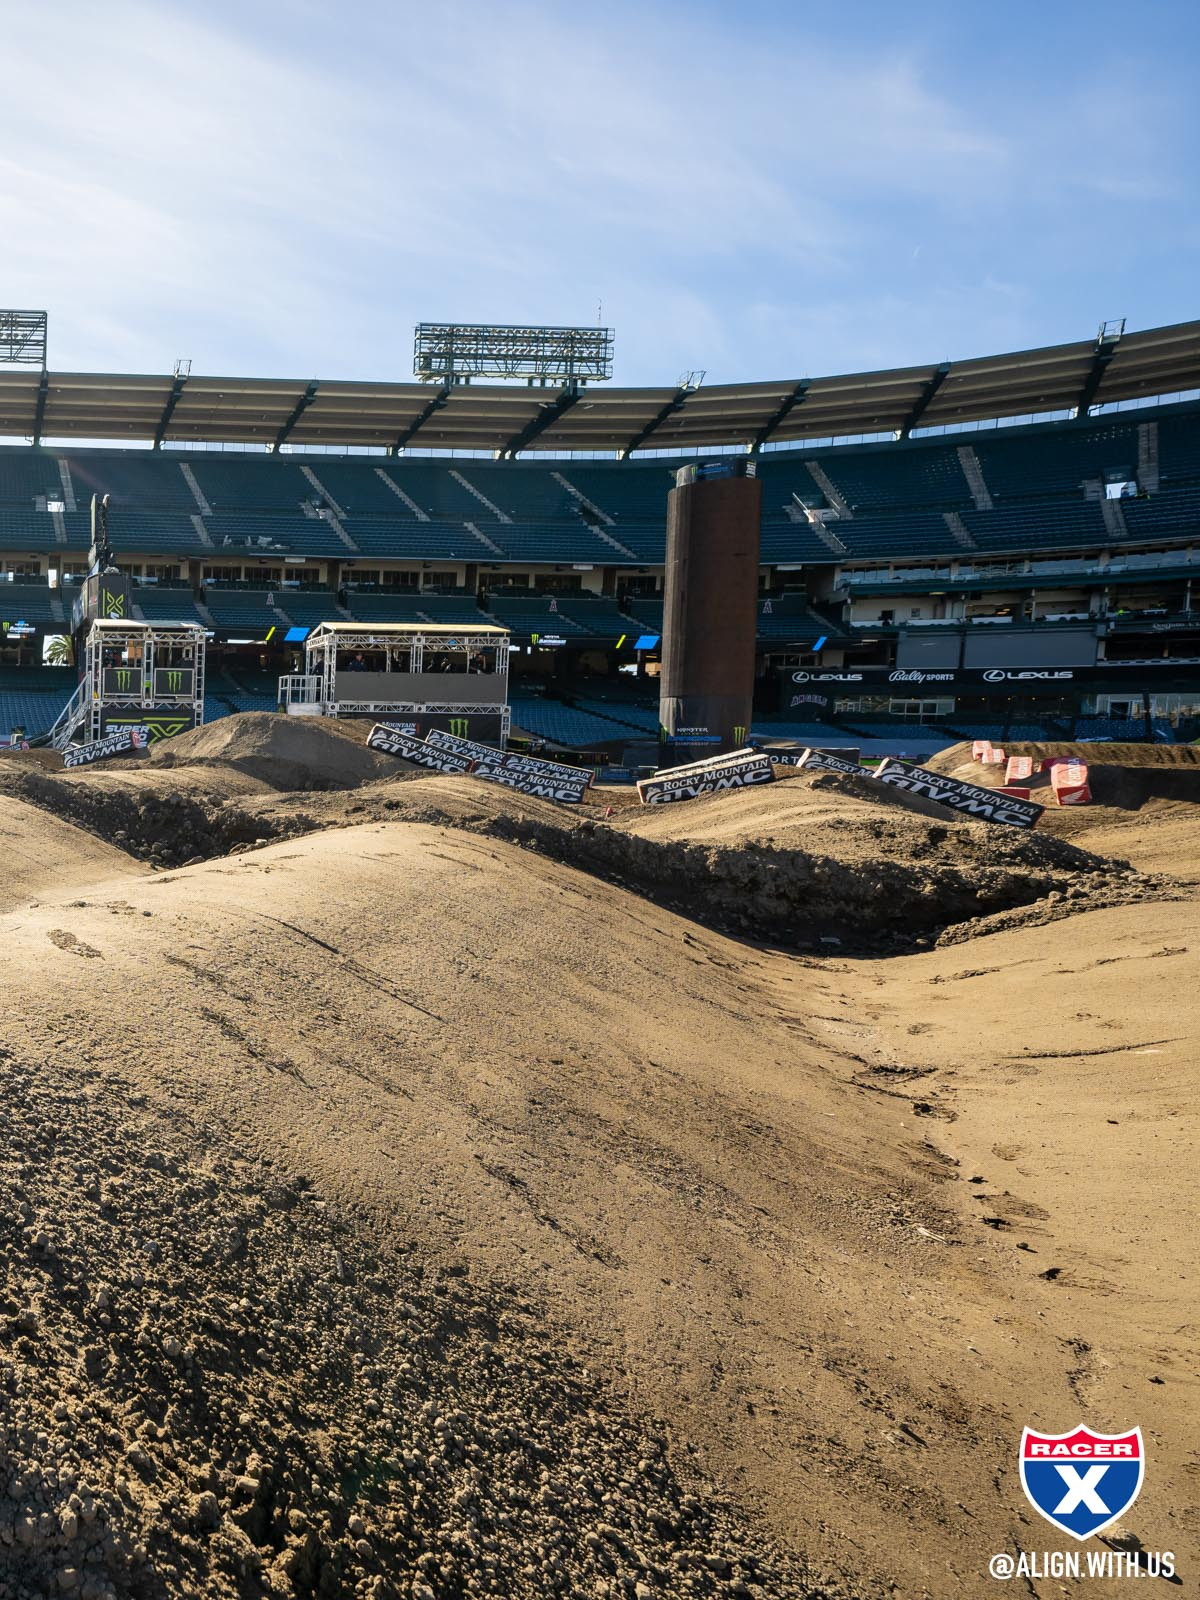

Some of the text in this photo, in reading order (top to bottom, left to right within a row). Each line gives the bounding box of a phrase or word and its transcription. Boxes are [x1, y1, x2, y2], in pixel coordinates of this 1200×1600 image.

[811, 673, 863, 681] LEXUS
[889, 670, 954, 684] Bally SPORTS
[1006, 671, 1073, 679] LEXUS
[105, 725, 149, 733] SUPER
[73, 746, 94, 757] ROCKY
[94, 732, 130, 750] MOUNTAIN
[388, 734, 469, 767] ROCKY MOUNTAIN
[442, 735, 505, 759] ROCKY MOUNTAIN
[520, 758, 547, 771] ROCKY
[547, 765, 591, 778] MOUNTAIN
[663, 776, 700, 791] ROCKY
[703, 760, 768, 781] MOUNTAIN
[824, 757, 858, 773] ROCKY
[492, 767, 584, 792] ROCKY MOUNTAIN
[909, 768, 1039, 816] ROCKY MOUNTAIN
